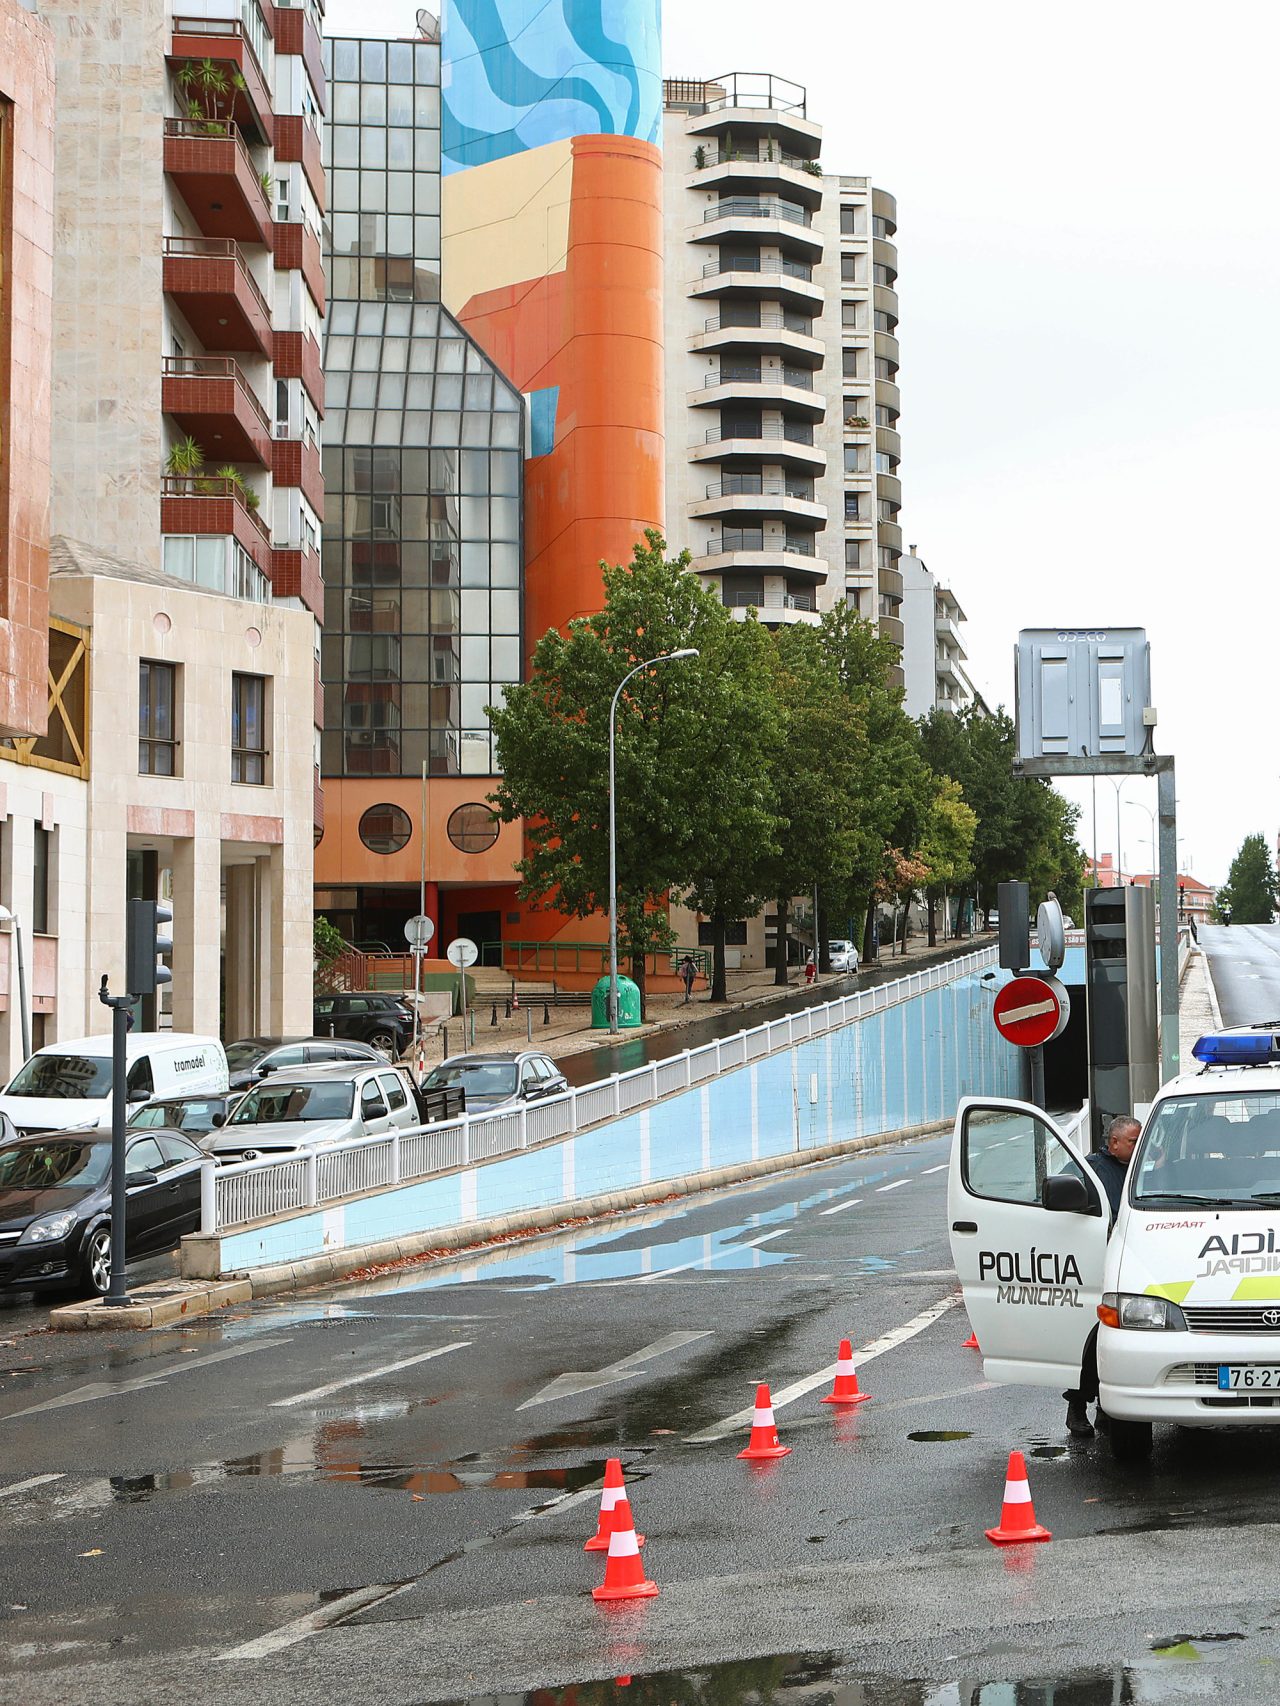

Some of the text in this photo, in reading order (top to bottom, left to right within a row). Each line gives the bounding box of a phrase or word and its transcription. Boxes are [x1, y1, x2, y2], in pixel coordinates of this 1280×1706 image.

[1057, 631, 1106, 642] ODECO
[979, 1247, 1083, 1285] POLÍCIA
[997, 1285, 1084, 1308] MUNICIPAL
